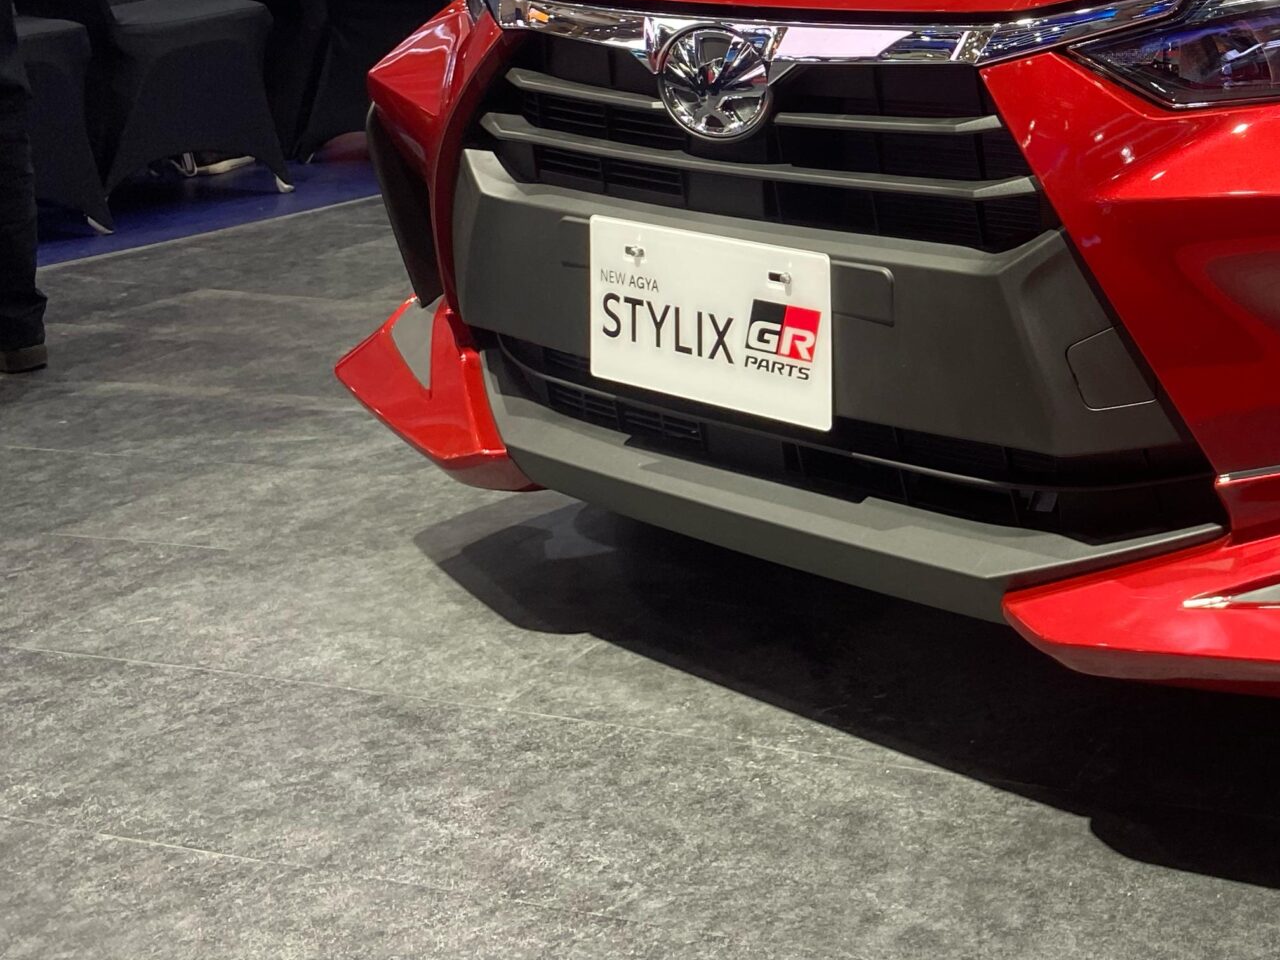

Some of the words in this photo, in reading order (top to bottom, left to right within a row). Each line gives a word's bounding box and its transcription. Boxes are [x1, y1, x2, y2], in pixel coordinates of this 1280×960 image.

[600, 268, 626, 286] NEW
[629, 274, 660, 292] AGYA
[602, 292, 735, 365] STYLIX
[747, 319, 818, 362] GR
[744, 355, 811, 381] PARTS
